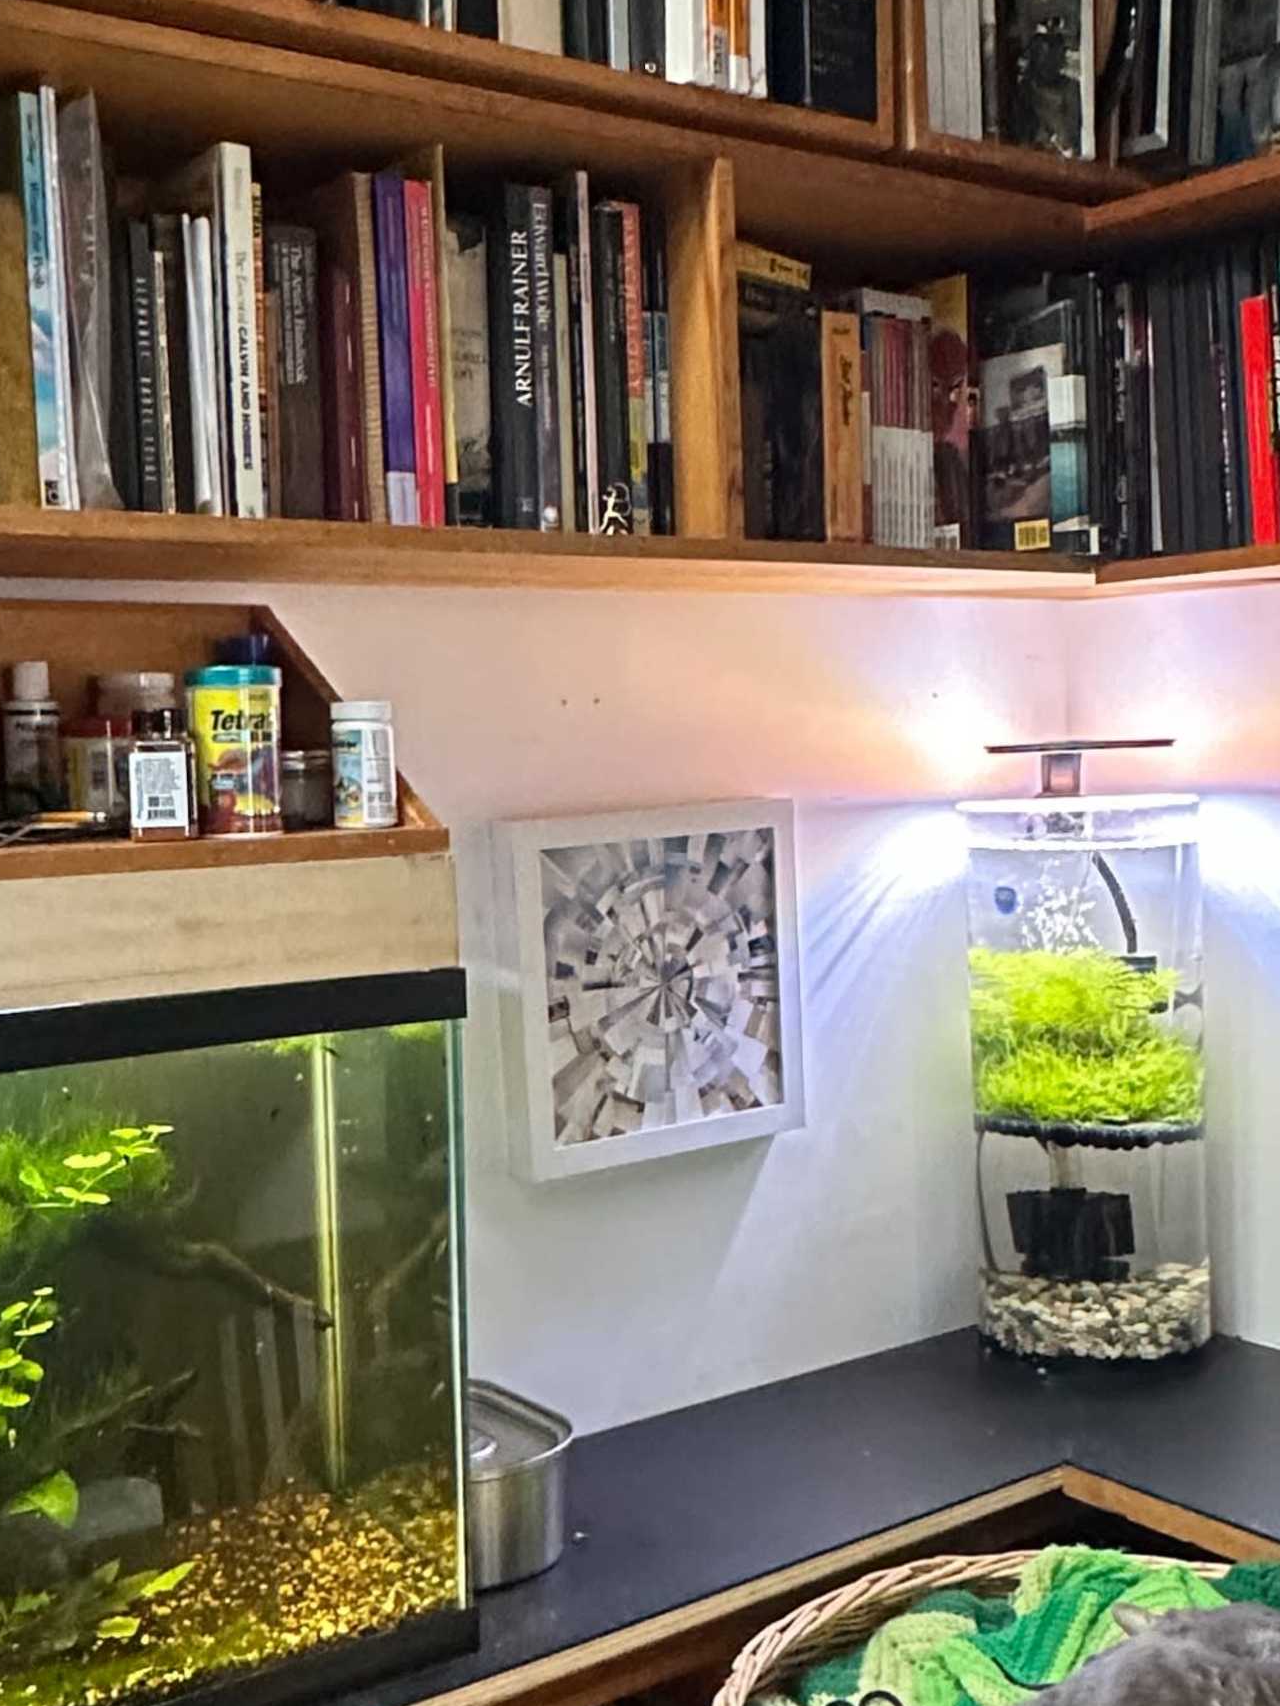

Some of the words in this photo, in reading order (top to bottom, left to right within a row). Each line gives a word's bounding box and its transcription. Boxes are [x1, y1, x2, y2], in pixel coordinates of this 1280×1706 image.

[510, 229, 532, 317] RAINER
[236, 326, 253, 377] CALVIN
[511, 318, 533, 406] ARNULF
[239, 381, 251, 410] AND
[240, 413, 255, 470] HOBBES
[211, 709, 266, 731] Tetra
